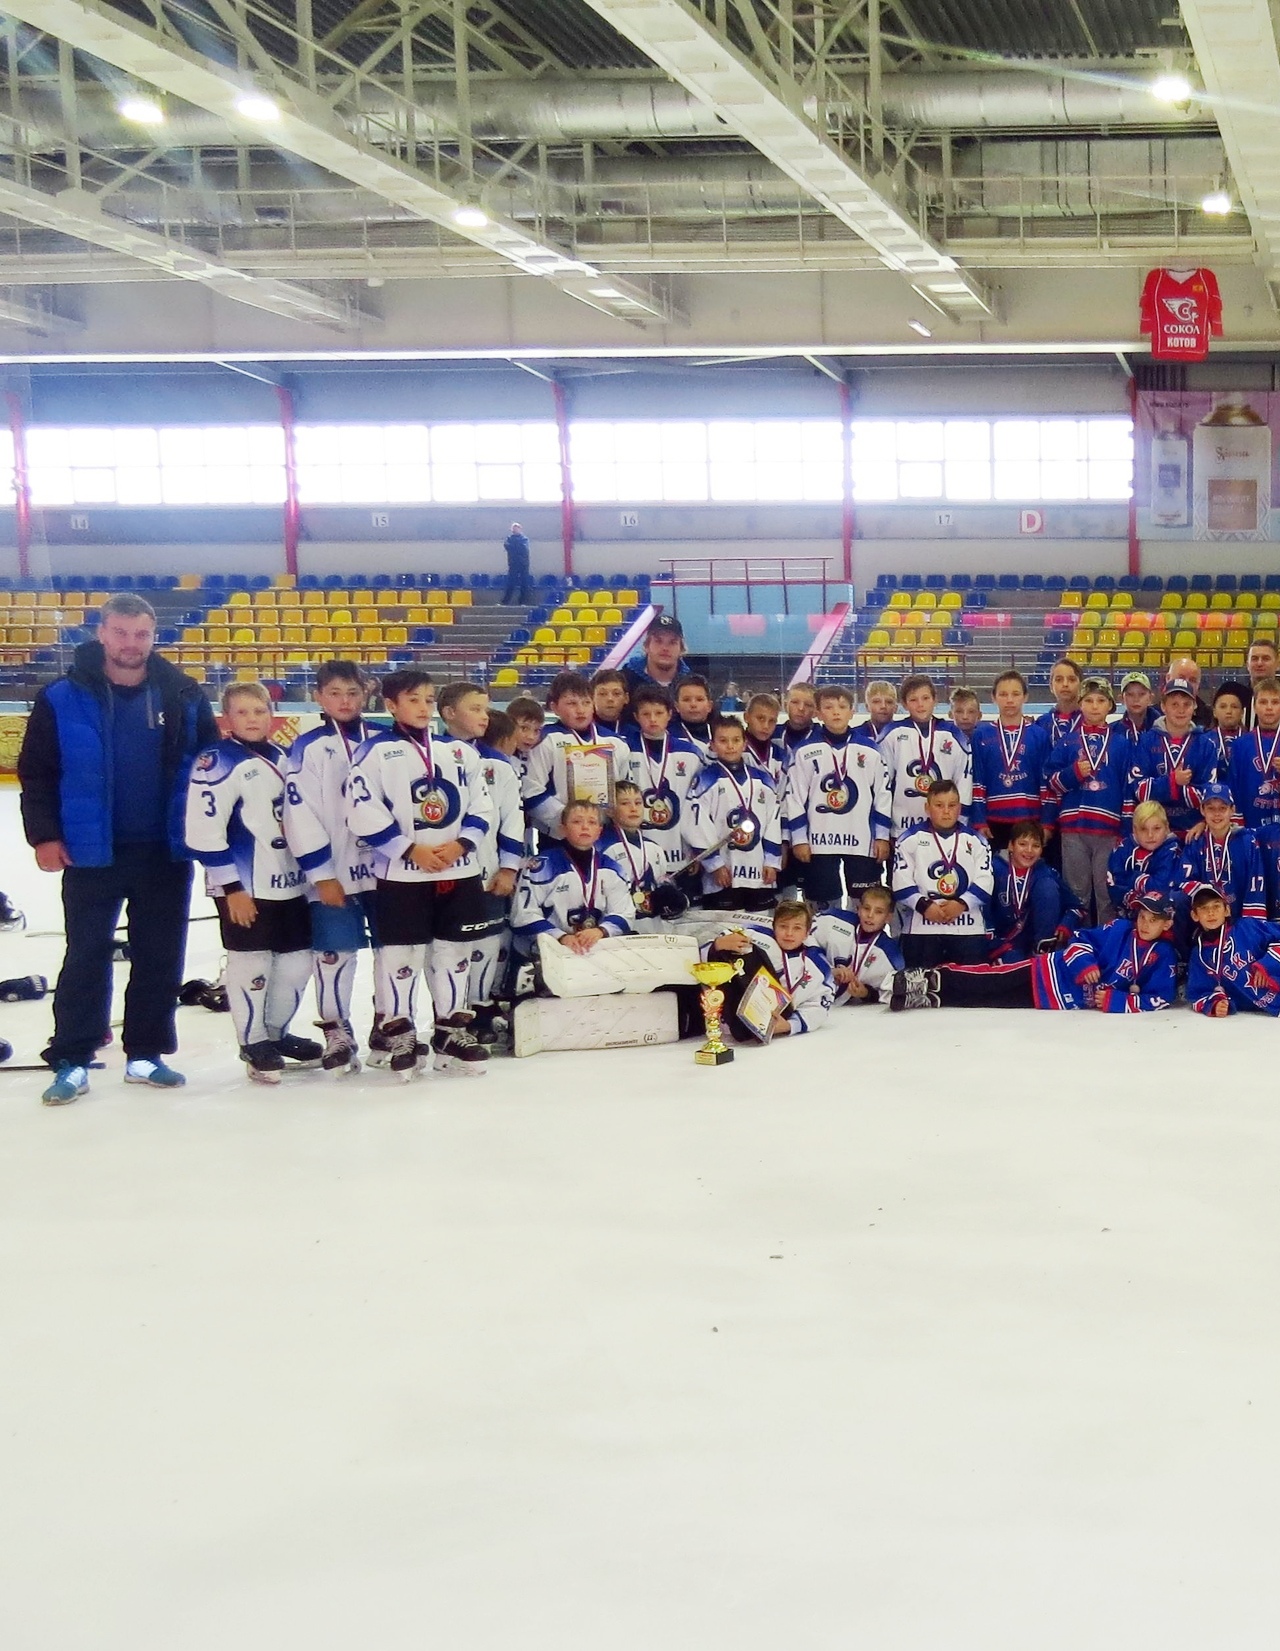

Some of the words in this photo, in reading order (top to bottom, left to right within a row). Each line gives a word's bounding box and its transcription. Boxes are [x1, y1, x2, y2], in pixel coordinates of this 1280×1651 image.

[1163, 324, 1201, 335] СОКОЛ
[1166, 337, 1197, 348] КОТОВ
[375, 516, 387, 527] 15
[623, 515, 636, 525] 16
[938, 515, 951, 525] 17
[1020, 511, 1042, 532] D
[811, 833, 860, 847] КАЗАНЬ
[1250, 876, 1265, 893] 17
